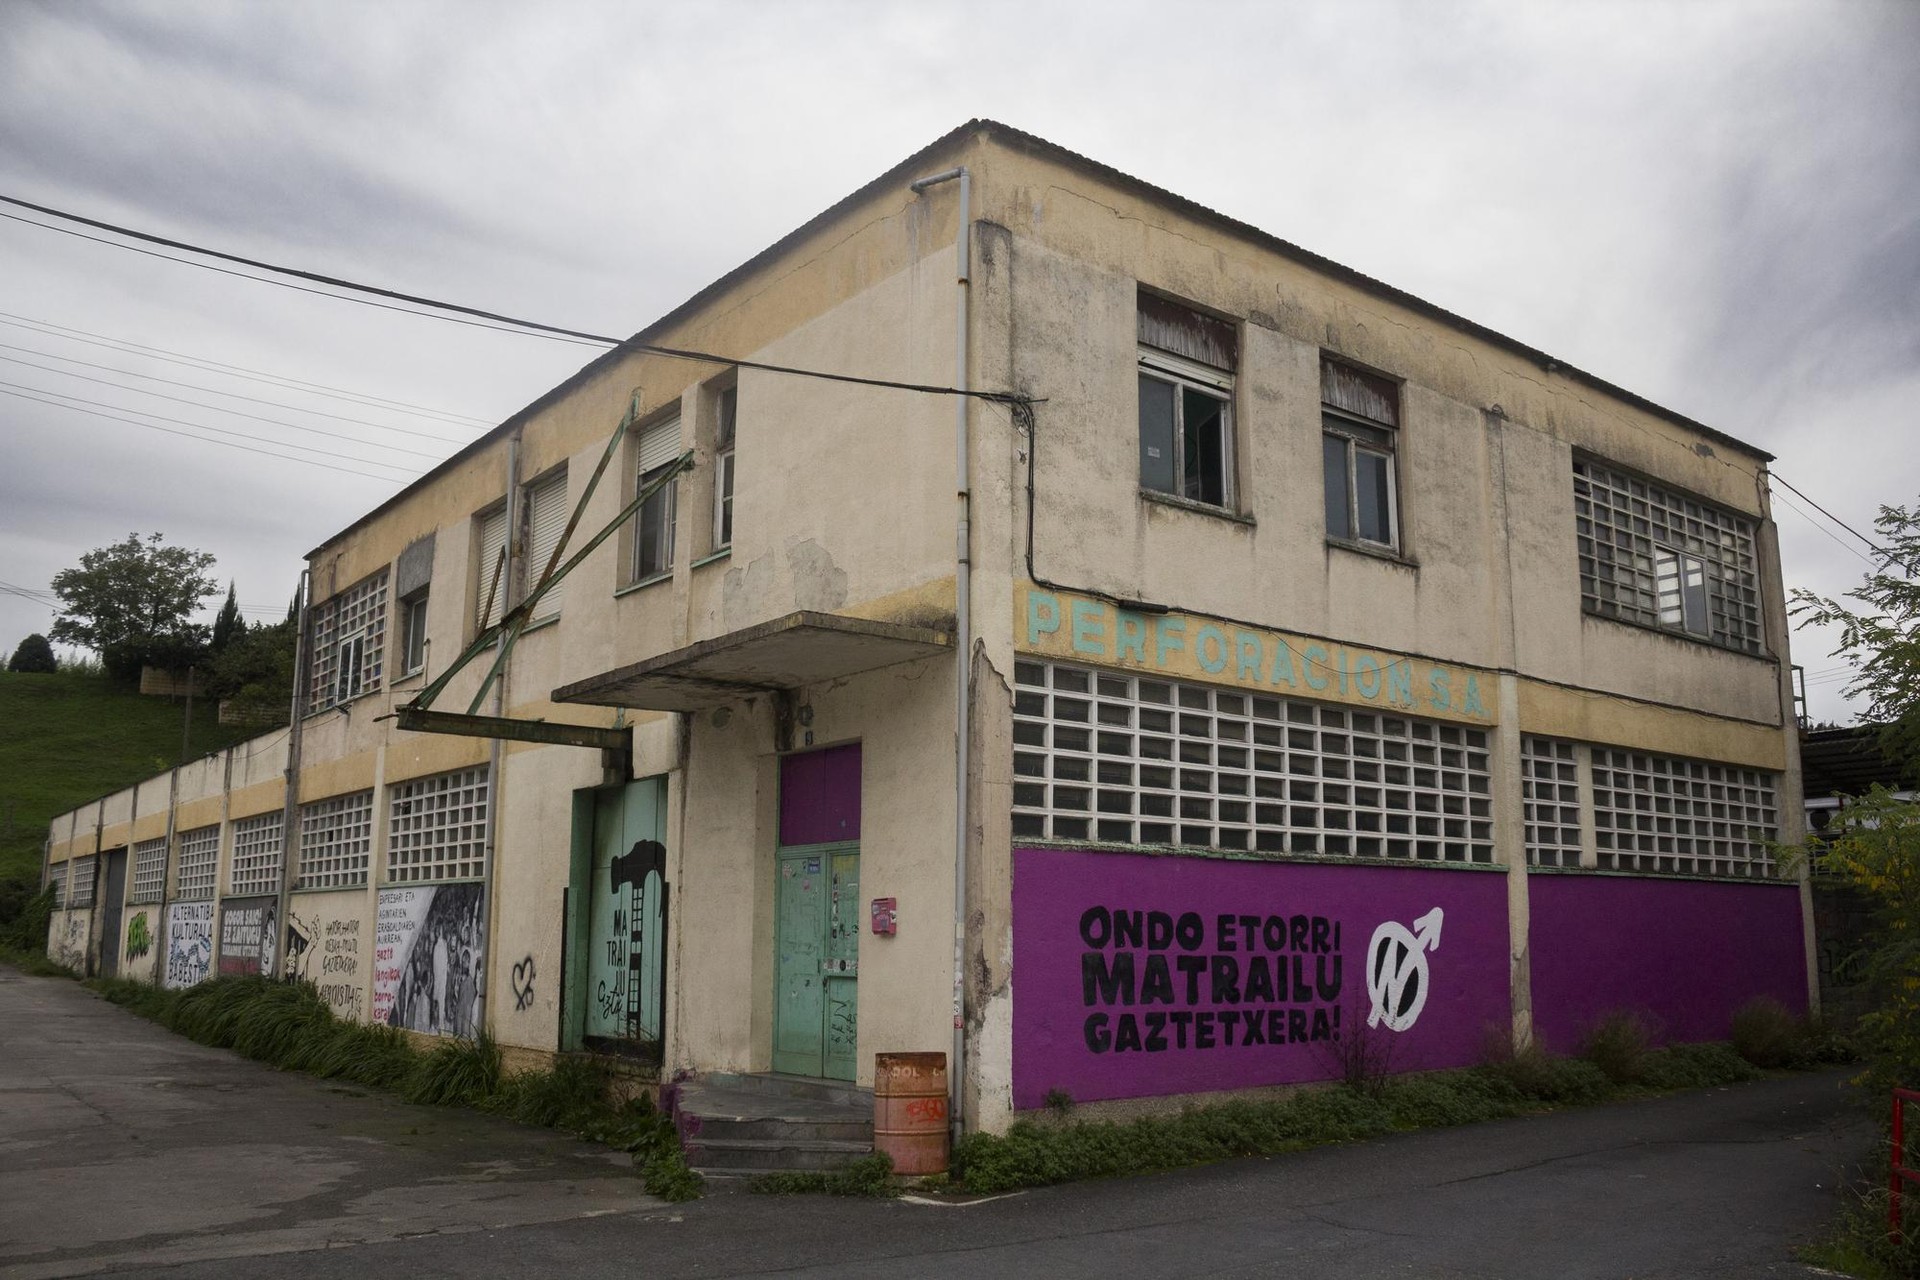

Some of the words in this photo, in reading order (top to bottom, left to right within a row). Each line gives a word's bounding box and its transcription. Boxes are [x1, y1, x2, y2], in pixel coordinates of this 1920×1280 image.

[614, 909, 627, 937] MA
[1080, 905, 1205, 950] ONDO
[1216, 914, 1341, 953] ETORRI
[606, 940, 627, 967] TRAI
[1081, 952, 1343, 1006] MATRAILU
[1083, 1005, 1341, 1054] GAZTETXERA!
